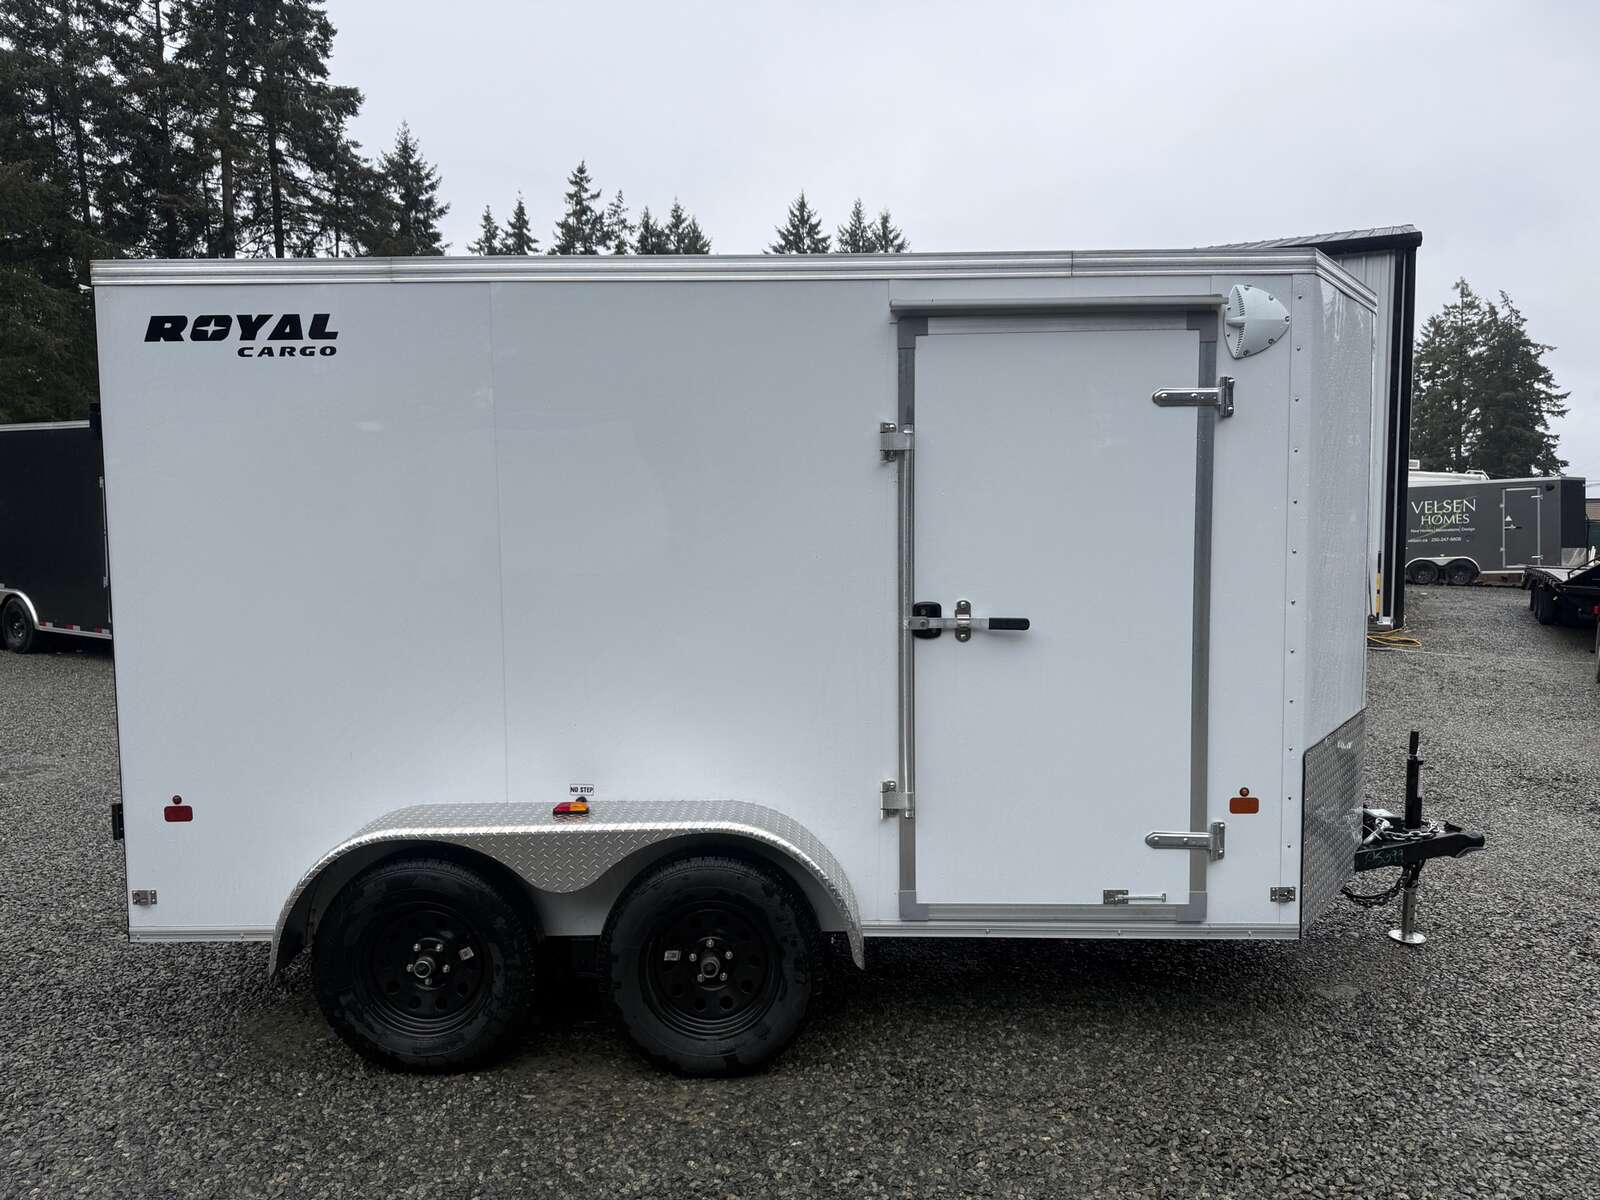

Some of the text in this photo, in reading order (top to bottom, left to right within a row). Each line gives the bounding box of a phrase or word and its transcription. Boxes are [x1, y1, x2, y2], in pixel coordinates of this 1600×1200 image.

[144, 313, 339, 342] ROYAL
[237, 345, 337, 358] CARGO
[1411, 499, 1476, 514] VELSEN
[1421, 514, 1470, 525] HOMES
